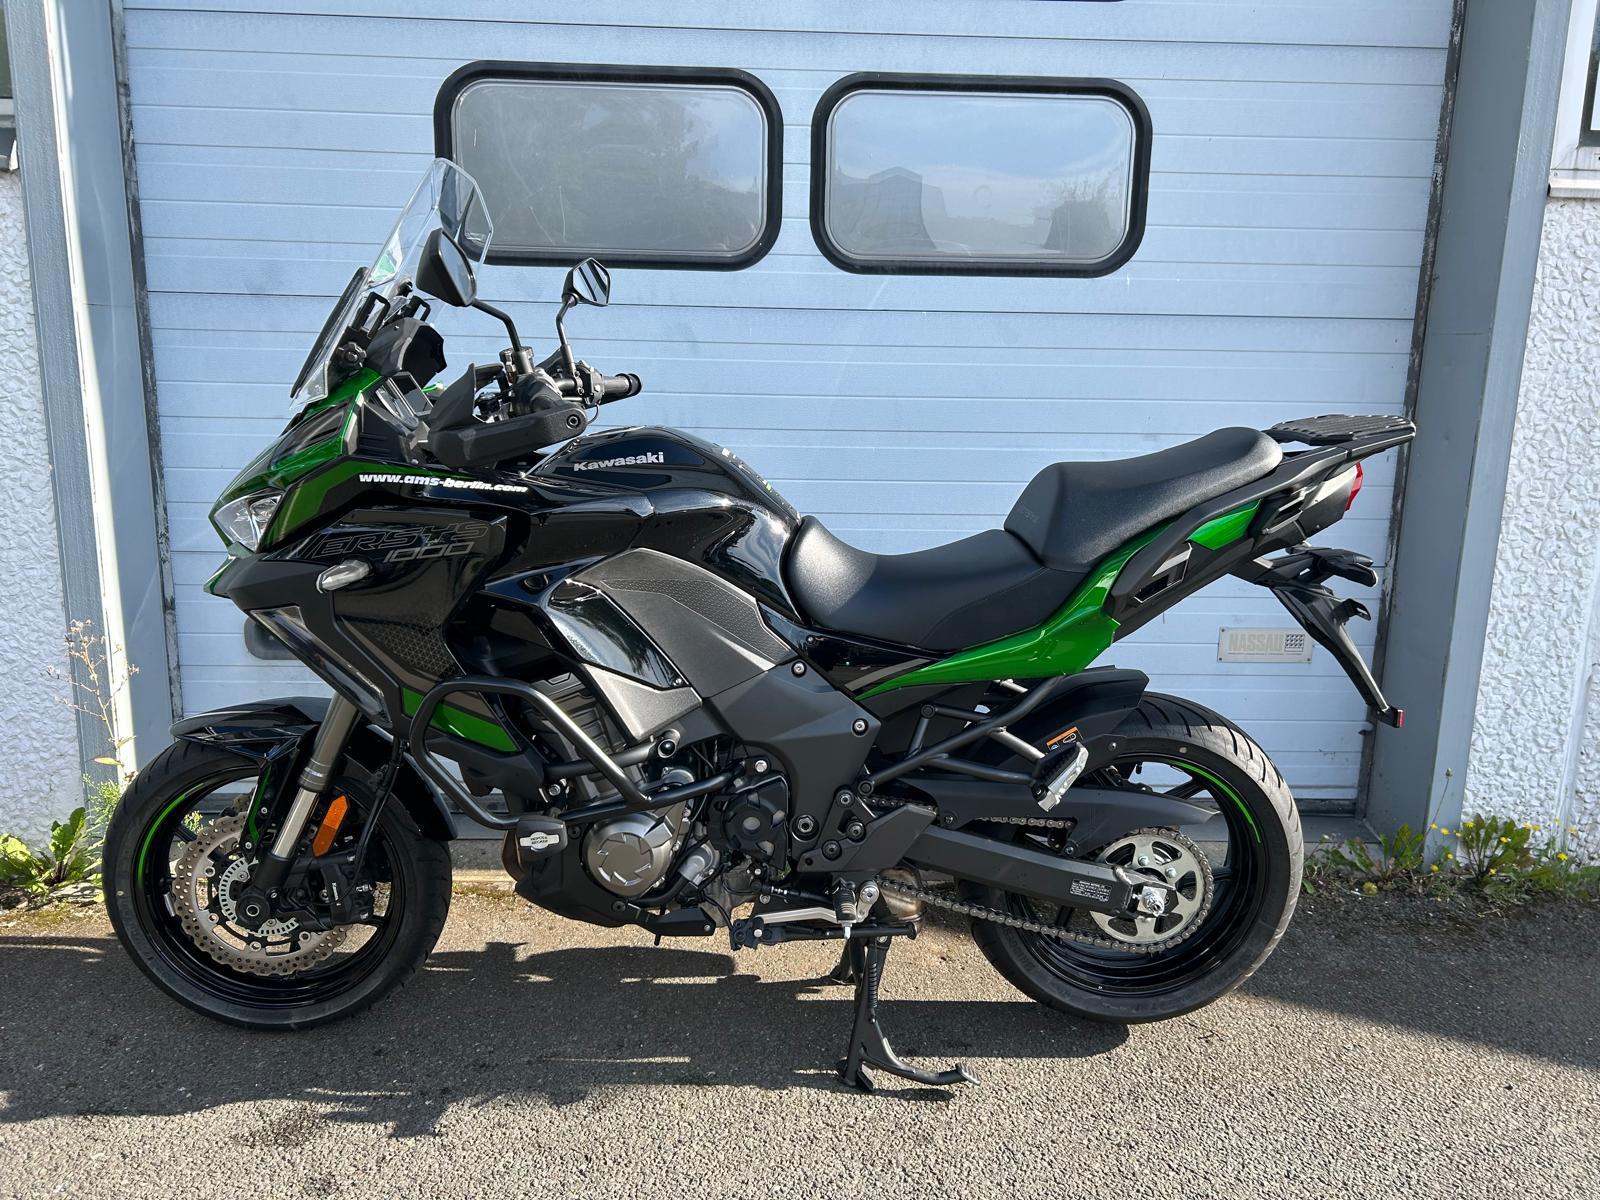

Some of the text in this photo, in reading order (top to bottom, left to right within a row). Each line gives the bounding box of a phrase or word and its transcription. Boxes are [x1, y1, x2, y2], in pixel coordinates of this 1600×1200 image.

[573, 452, 664, 471] Kawasaki
[359, 474, 529, 493] www.ams-berlin.com
[383, 541, 475, 563] 1000
[1228, 633, 1284, 652] NASSAU
